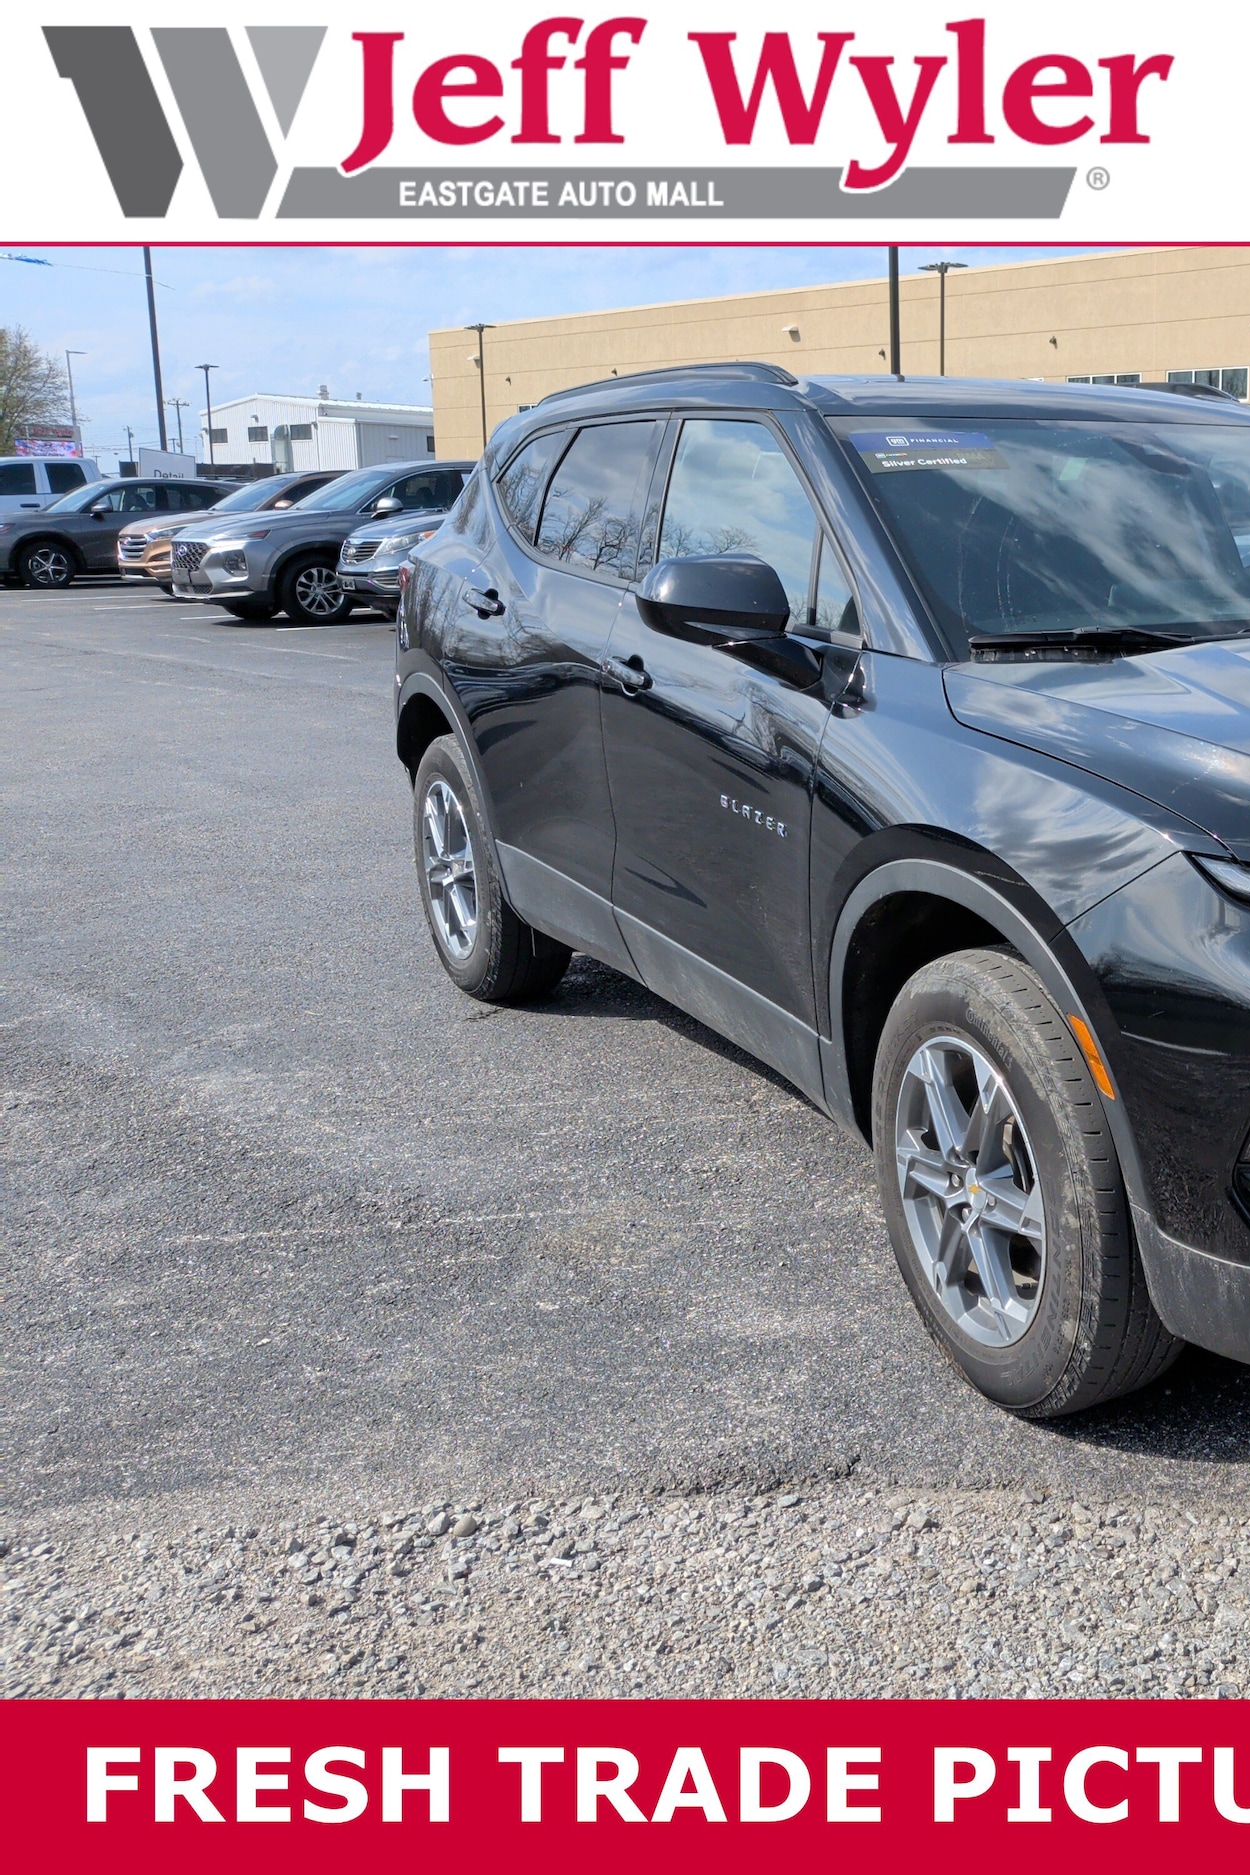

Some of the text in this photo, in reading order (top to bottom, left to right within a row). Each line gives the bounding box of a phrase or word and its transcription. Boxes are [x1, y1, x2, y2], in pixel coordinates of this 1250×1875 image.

[882, 457, 967, 468] Silver Certified
[719, 794, 788, 838] BLAZER
